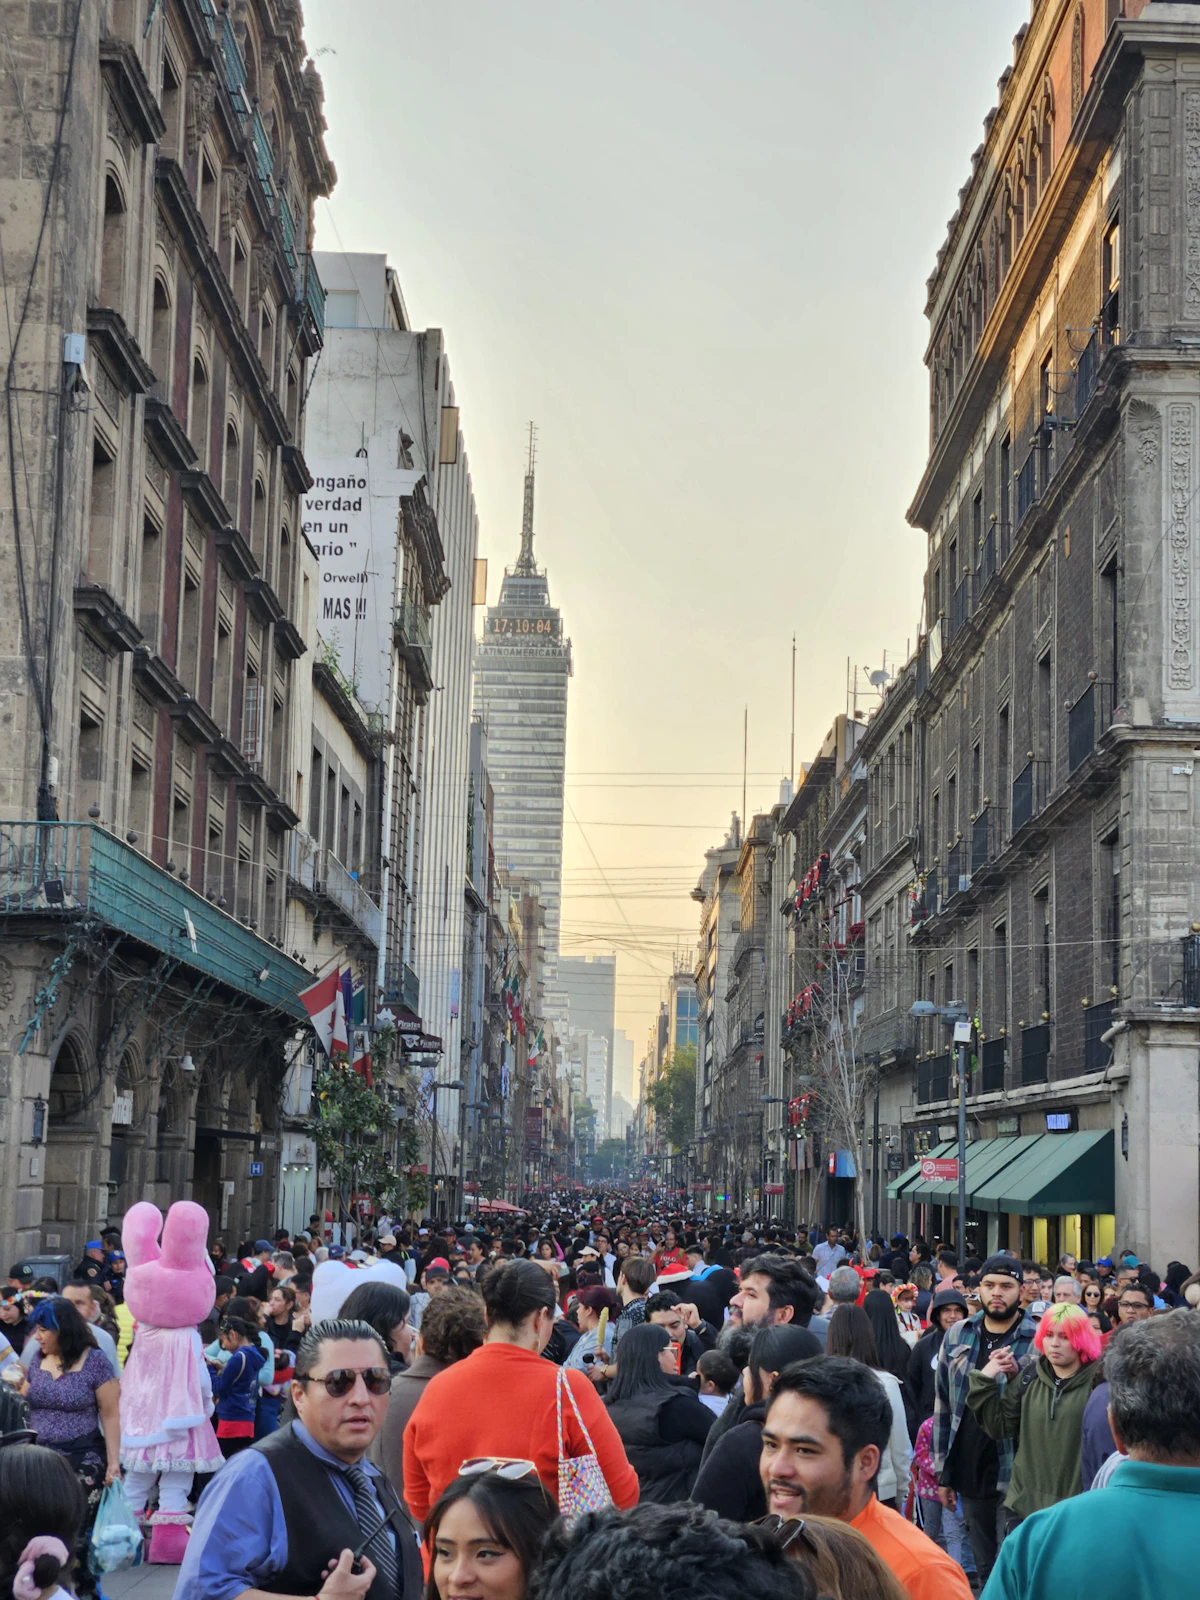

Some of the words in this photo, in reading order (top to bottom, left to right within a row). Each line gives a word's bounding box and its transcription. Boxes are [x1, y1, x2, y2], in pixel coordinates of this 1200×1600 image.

[315, 474, 367, 492] ngaño
[305, 496, 362, 511] verdad
[303, 522, 322, 533] en
[329, 522, 348, 533] un
[322, 597, 351, 619] MAS
[494, 618, 552, 633] 17:10:04
[478, 648, 564, 657] LATINOAMERICANA
[252, 1163, 261, 1174] H
